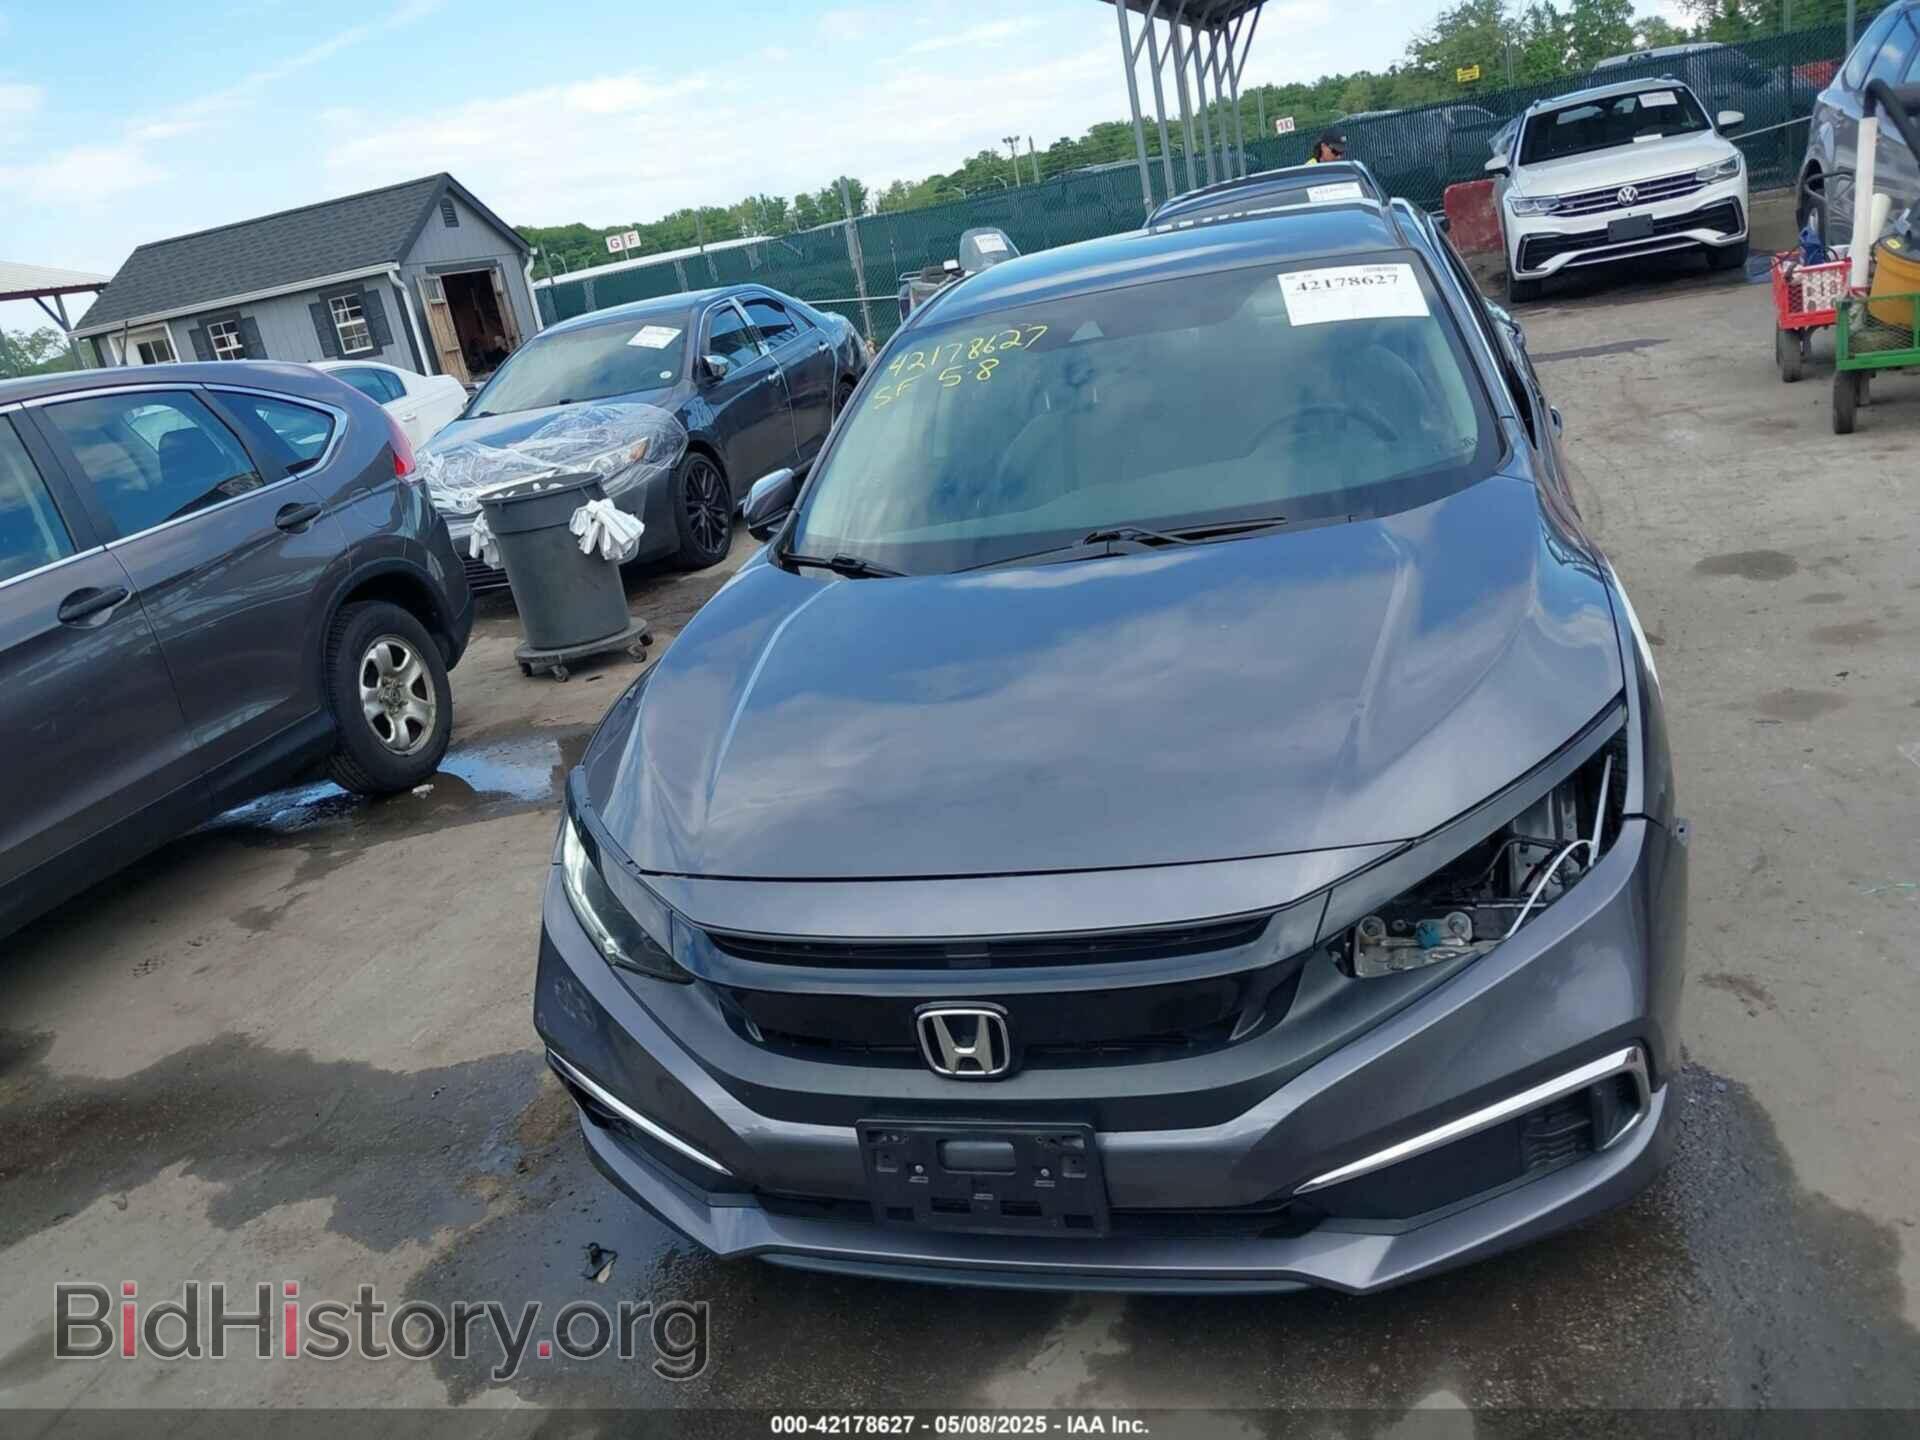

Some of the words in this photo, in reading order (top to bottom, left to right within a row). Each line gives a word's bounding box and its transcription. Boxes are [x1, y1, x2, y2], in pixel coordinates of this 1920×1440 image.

[1278, 119, 1293, 131] 10
[610, 238, 620, 249] G
[627, 233, 636, 245] F
[1296, 274, 1399, 291] 42178627
[889, 325, 1048, 377] 42178627
